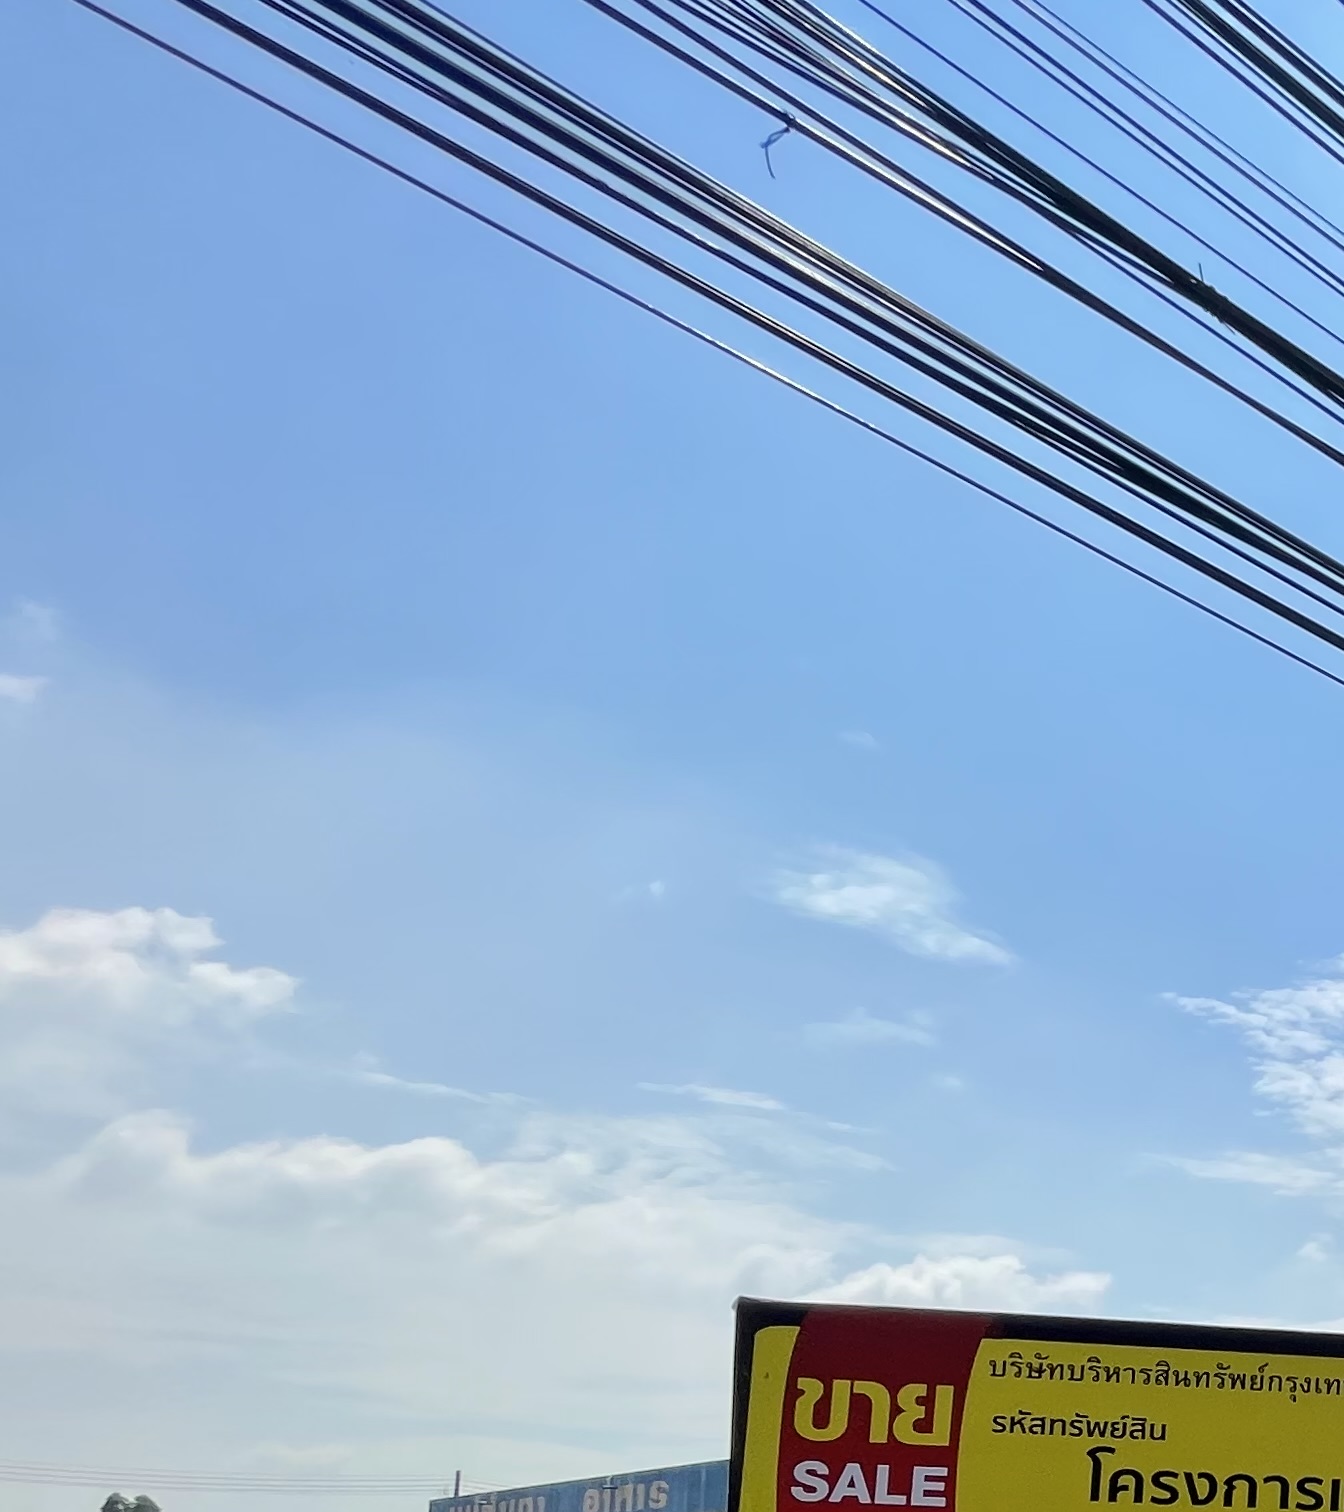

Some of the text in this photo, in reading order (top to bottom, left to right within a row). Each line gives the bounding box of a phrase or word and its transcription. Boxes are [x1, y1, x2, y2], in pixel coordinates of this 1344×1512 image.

[793, 1376, 954, 1447] ขาย
[991, 1410, 1167, 1442] รหัสทรัพย์สิน
[791, 1460, 949, 1507] SALE
